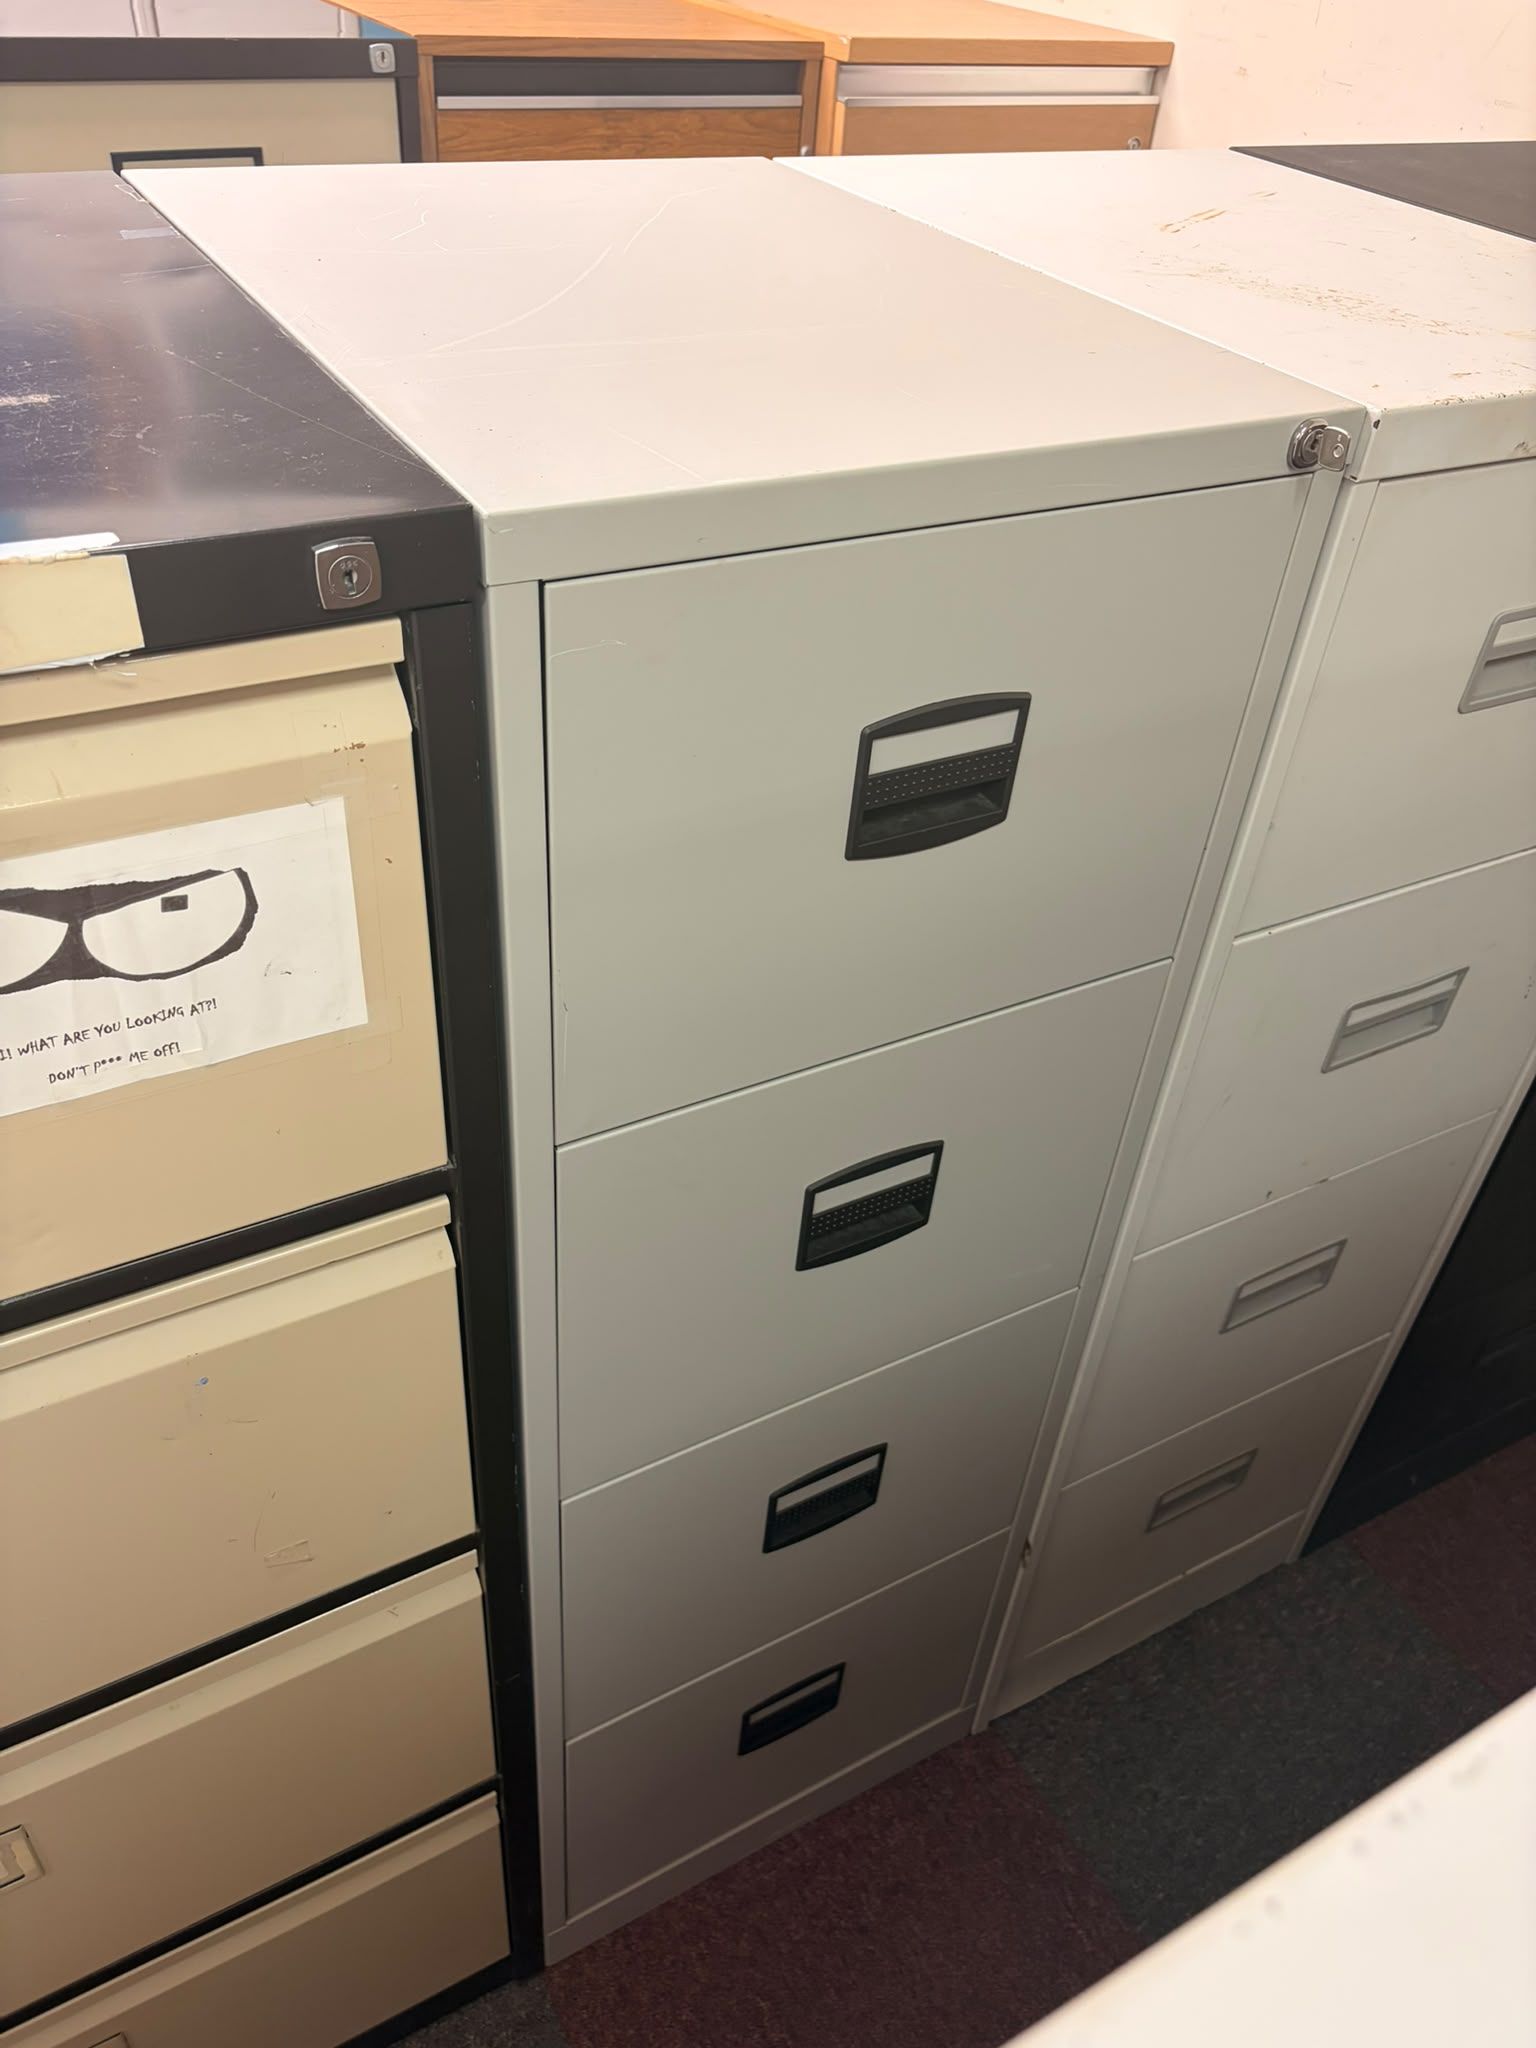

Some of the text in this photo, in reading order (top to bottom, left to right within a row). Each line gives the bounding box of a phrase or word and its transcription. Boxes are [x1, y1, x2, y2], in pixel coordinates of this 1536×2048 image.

[17, 1035, 59, 1056] WHAT
[63, 1029, 91, 1046] ARE
[93, 1021, 121, 1037] YOU
[126, 1006, 185, 1029] LOOKING
[189, 998, 218, 1016] AT?!
[48, 1065, 90, 1084] DON'T
[128, 1050, 149, 1063] ME
[153, 1042, 181, 1057] OFF!
